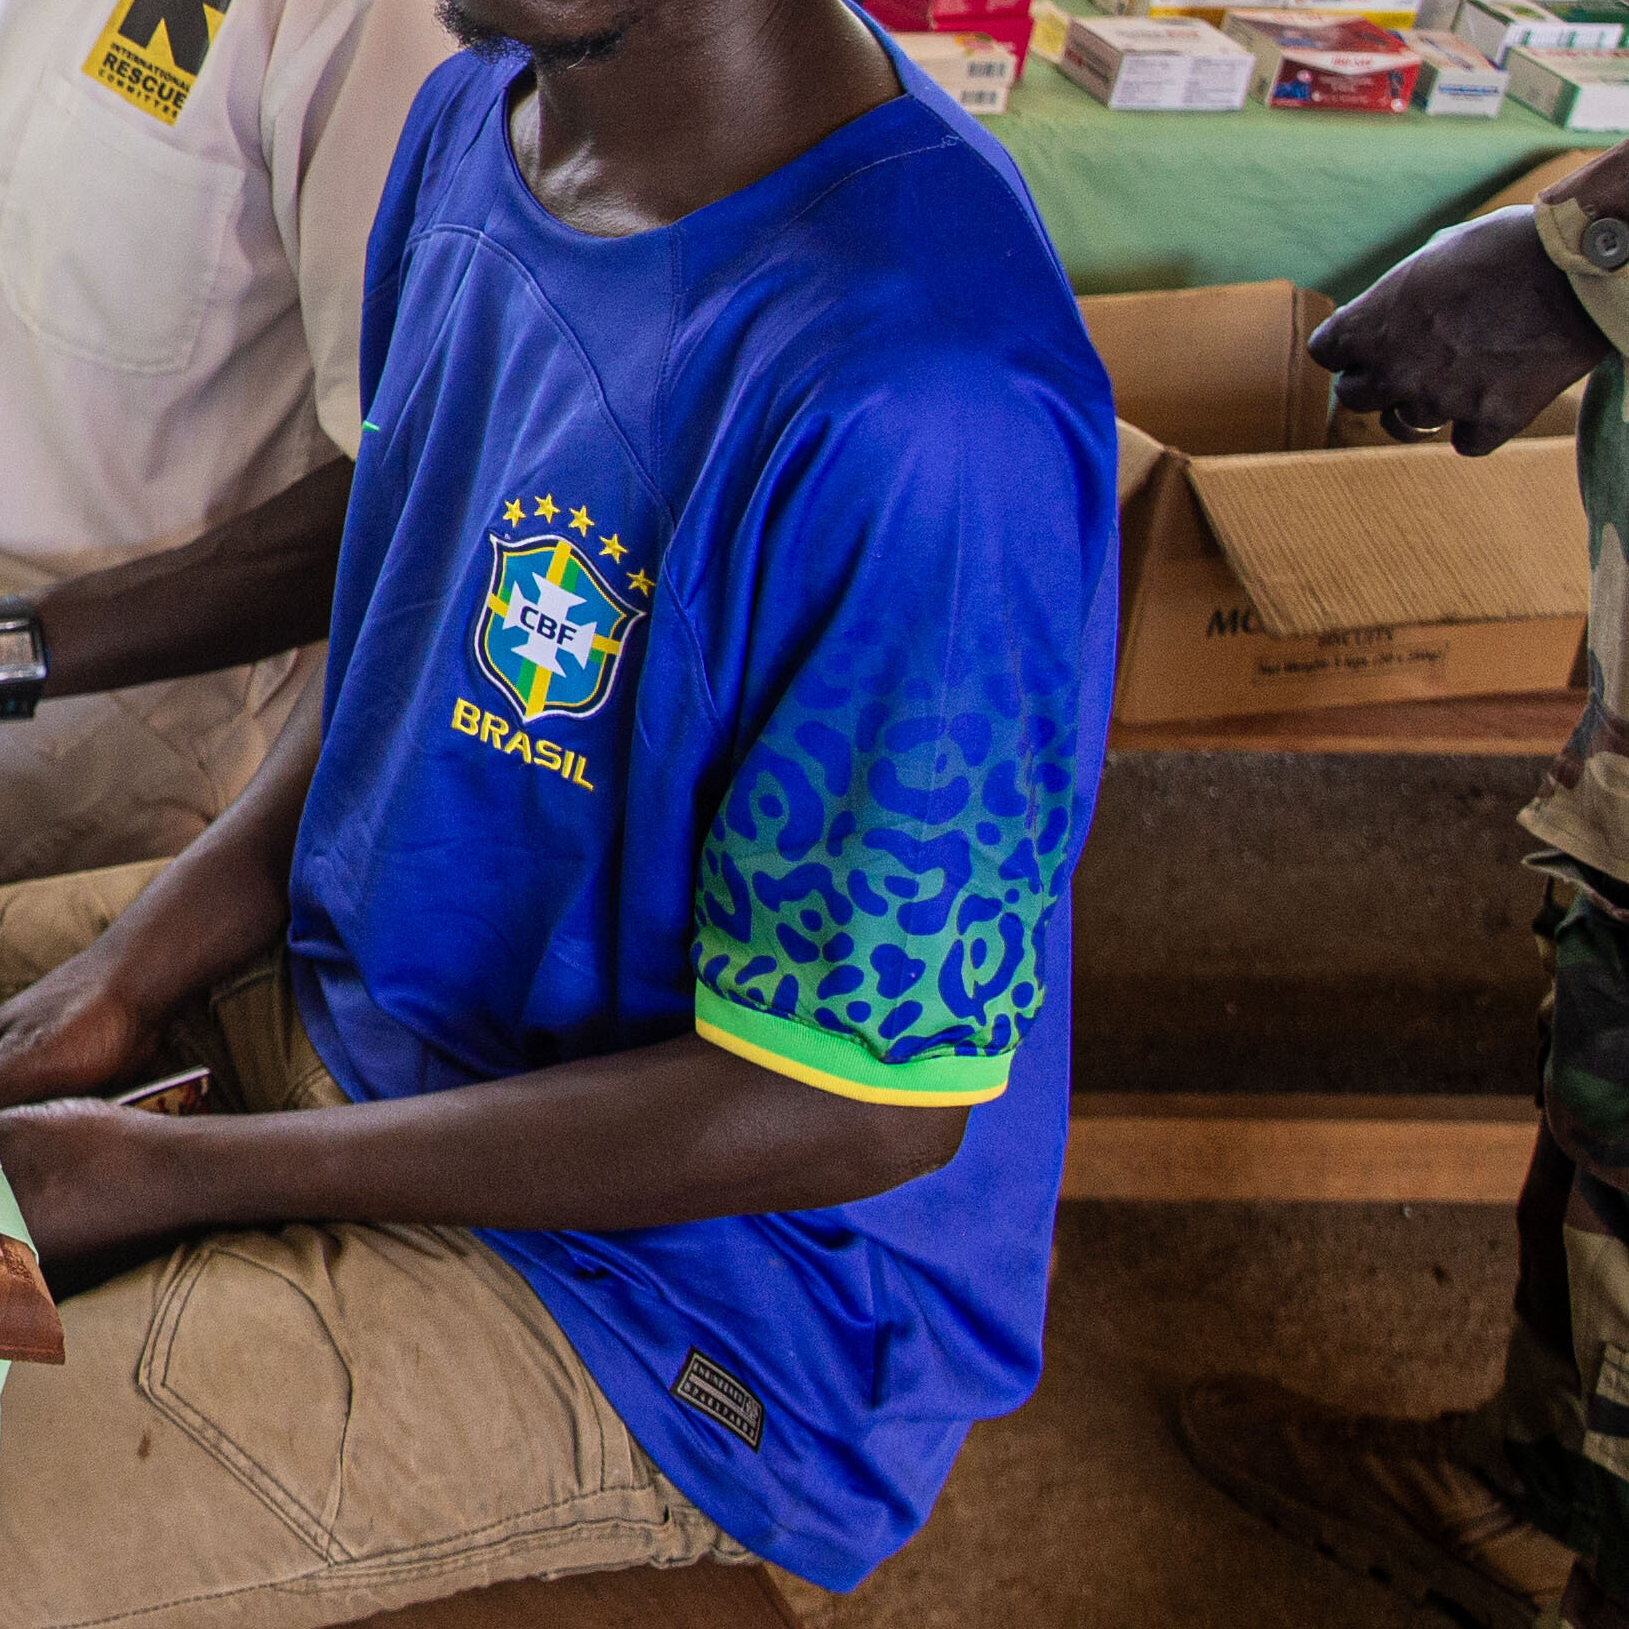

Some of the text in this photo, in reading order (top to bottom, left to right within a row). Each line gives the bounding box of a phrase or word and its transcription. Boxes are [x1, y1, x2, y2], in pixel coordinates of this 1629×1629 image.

[102, 51, 188, 110] RESCUE
[109, 41, 191, 93] INTERNATIONAL
[97, 69, 178, 119] COMMITTEE
[519, 605, 577, 645] CBF
[450, 696, 595, 792] BRASIL
